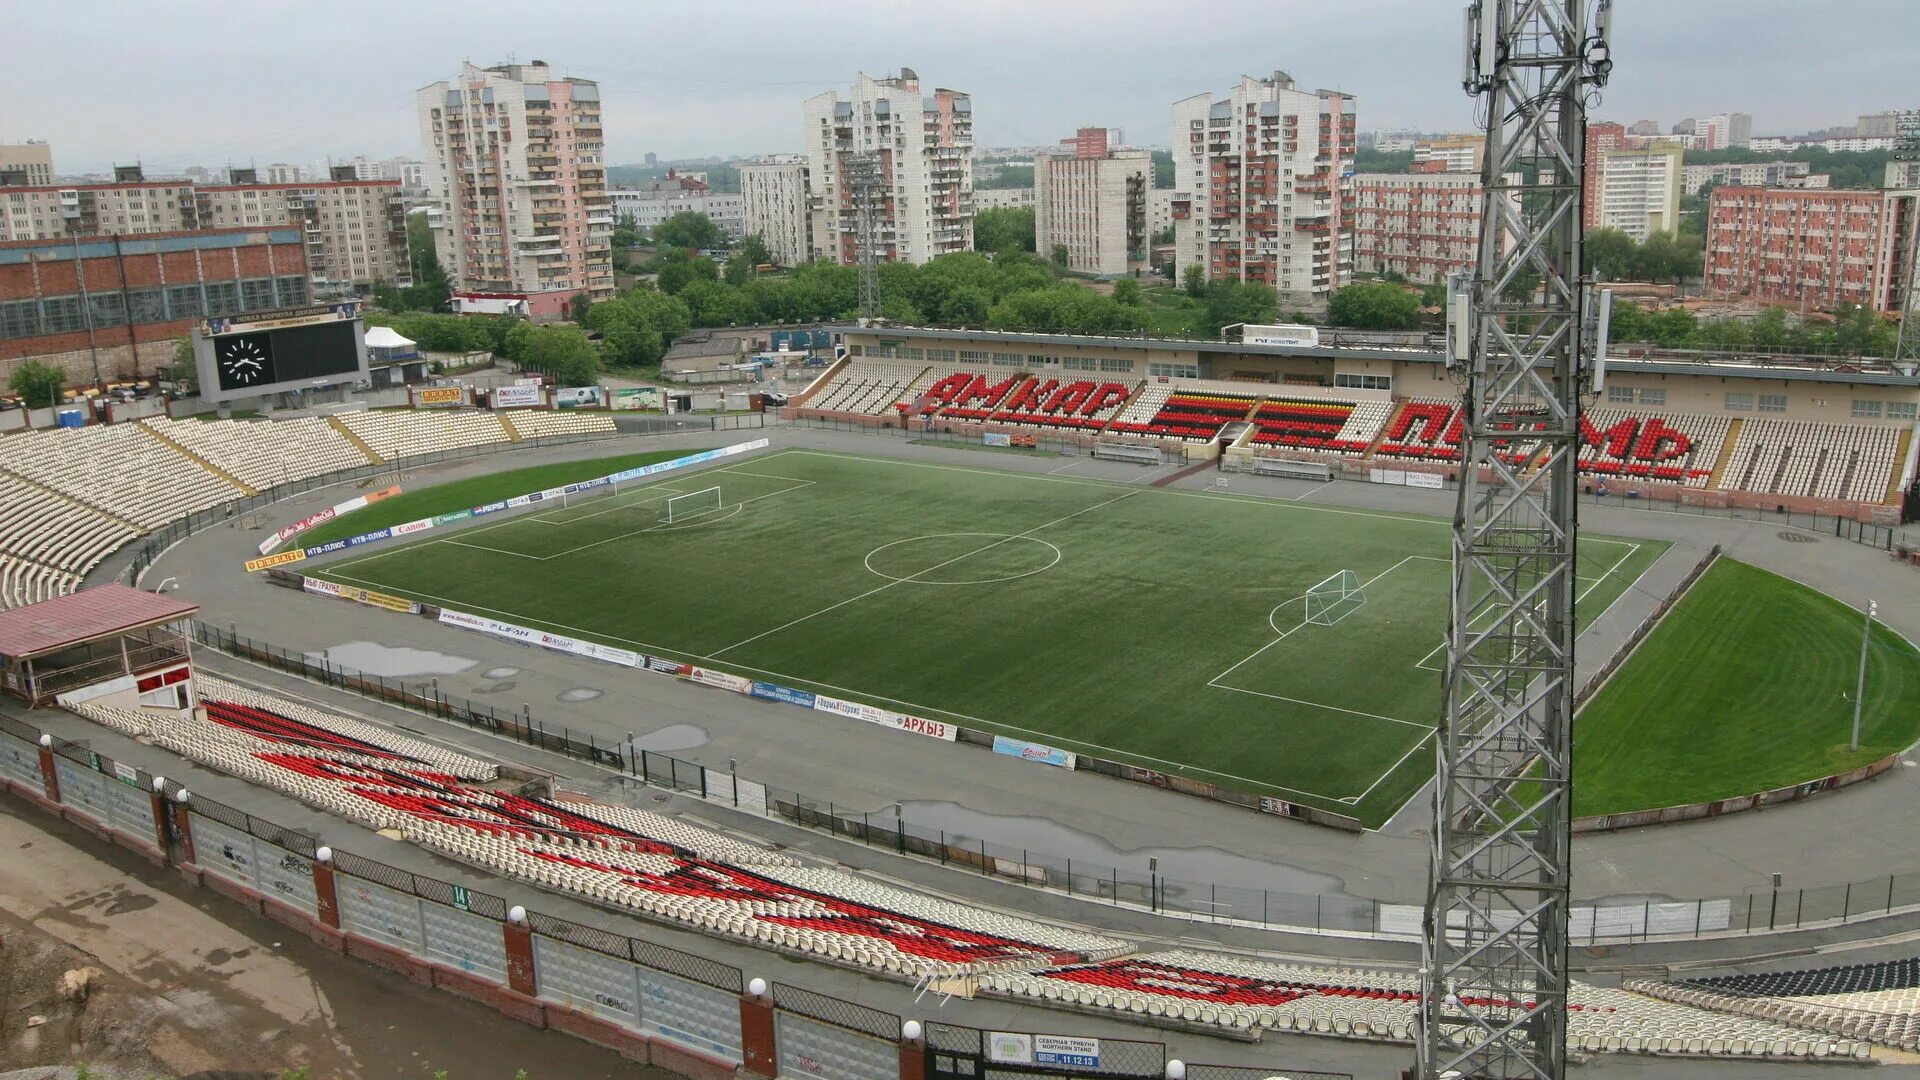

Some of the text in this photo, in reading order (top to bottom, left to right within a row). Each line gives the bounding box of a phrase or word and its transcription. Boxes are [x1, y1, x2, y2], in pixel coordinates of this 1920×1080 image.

[236, 307, 330, 323] НОВАЯ ФОРМУЛА ДВИЖЕНИЯ
[924, 372, 1130, 416] АМКАР
[1387, 402, 1691, 460] ПМЬ
[544, 487, 564, 498] СОГАЗ
[482, 501, 505, 513] PEPSI
[508, 496, 529, 506] СОГАЗ
[398, 521, 426, 533] Canon
[351, 530, 389, 545] НТВ-ПЛЮС
[307, 540, 346, 556] НТВ-ПЛЮС
[305, 577, 318, 588] НЬЮ
[318, 580, 340, 593] ГРАУНД
[359, 591, 367, 601] 15
[498, 624, 529, 637] LIFAN
[903, 716, 945, 737] АРХЫЗ
[454, 886, 466, 904] 14
[1038, 1037, 1068, 1045] СЕВЕРНАЯ
[1042, 1043, 1073, 1051] NORTHERN
